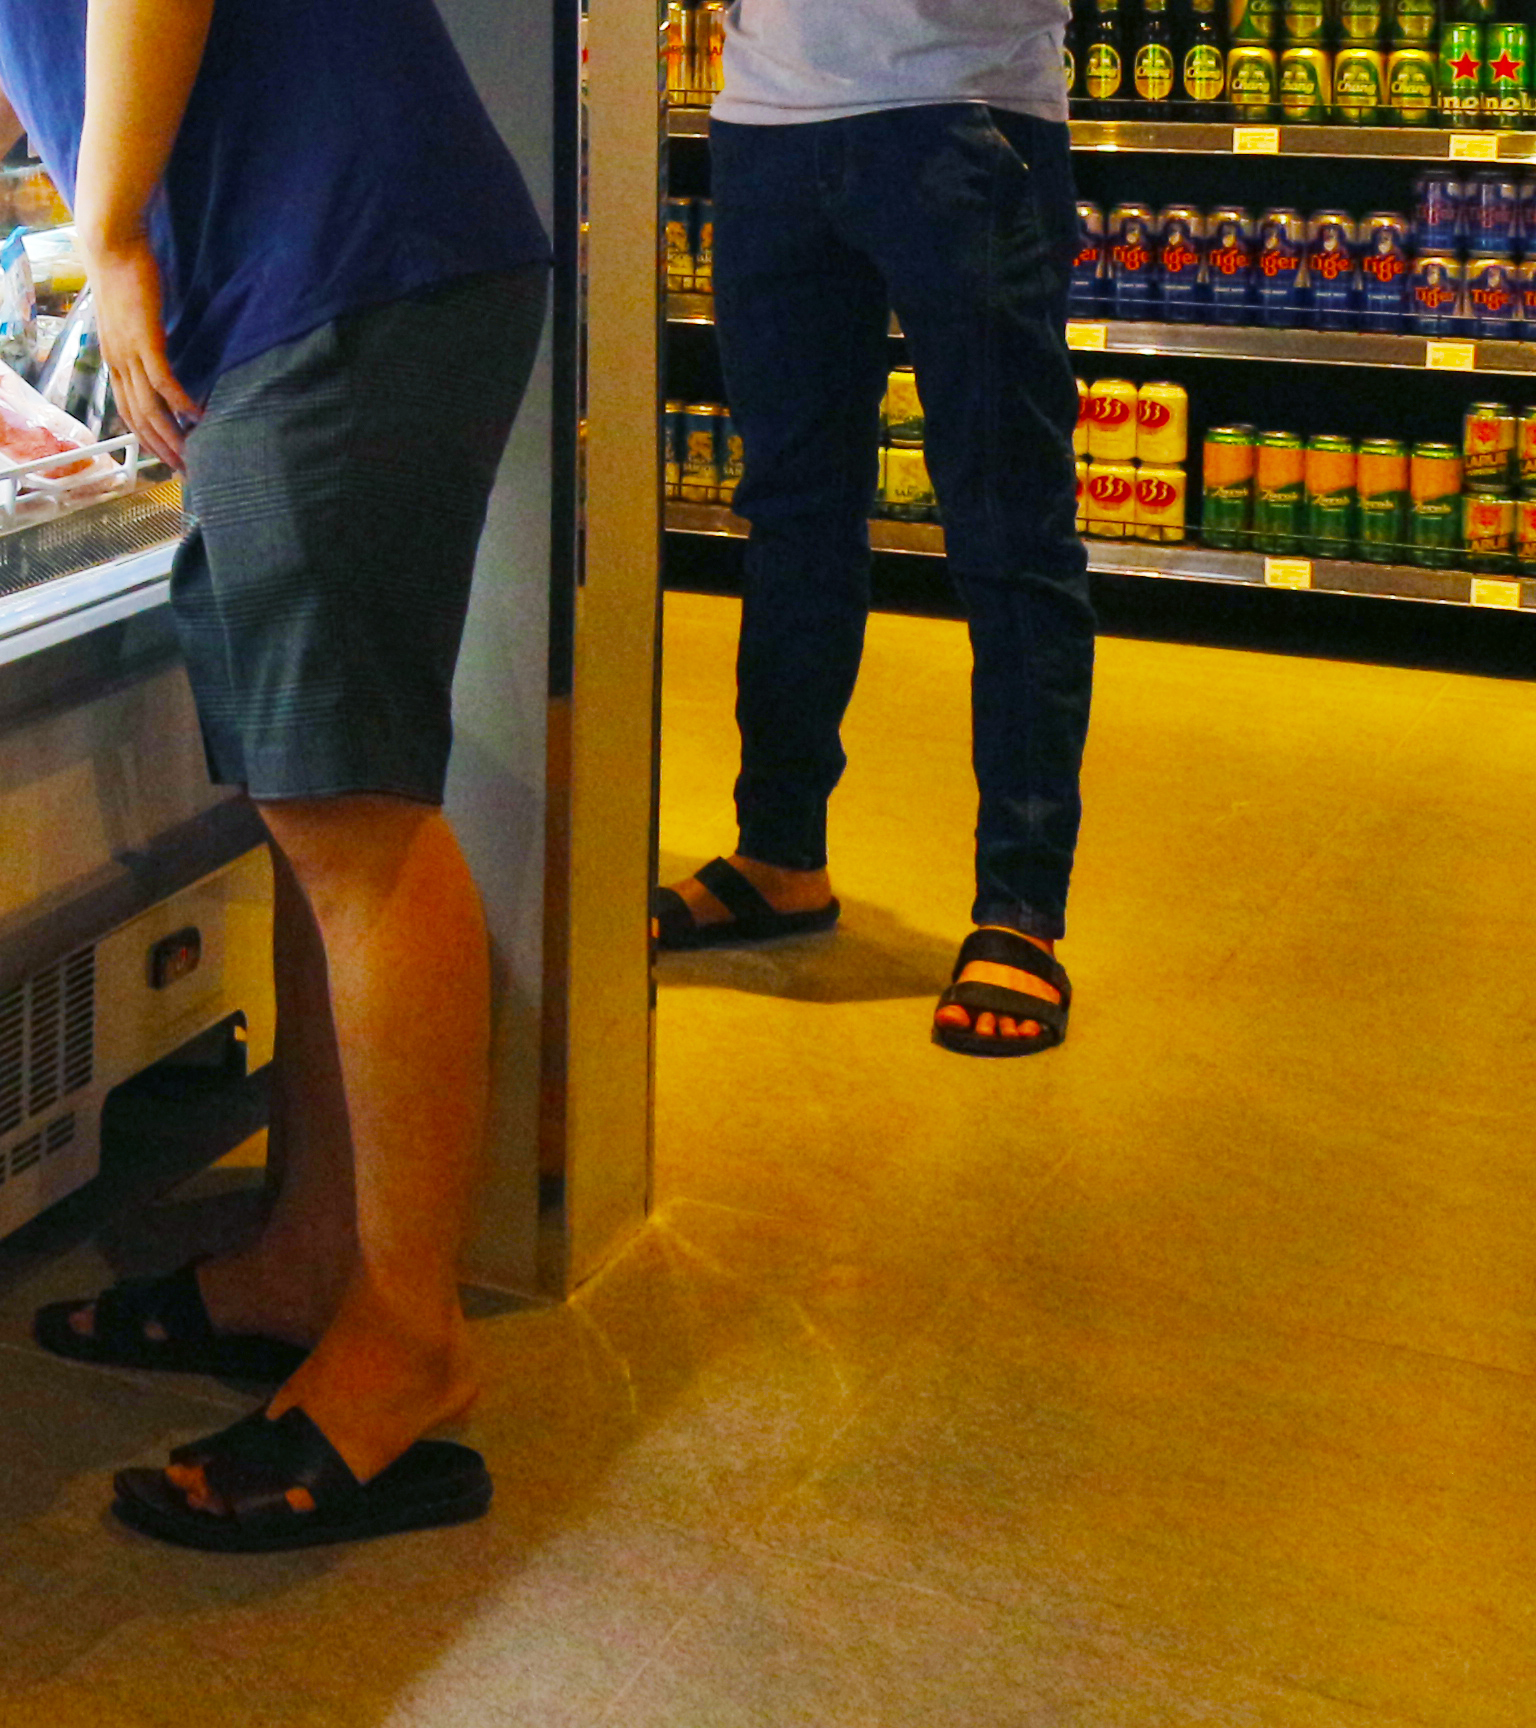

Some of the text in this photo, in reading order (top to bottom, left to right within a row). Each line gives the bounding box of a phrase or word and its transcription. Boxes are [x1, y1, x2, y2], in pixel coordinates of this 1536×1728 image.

[1232, 78, 1270, 93] Chang
[1337, 79, 1377, 95] Chang
[1391, 80, 1432, 96] Chang
